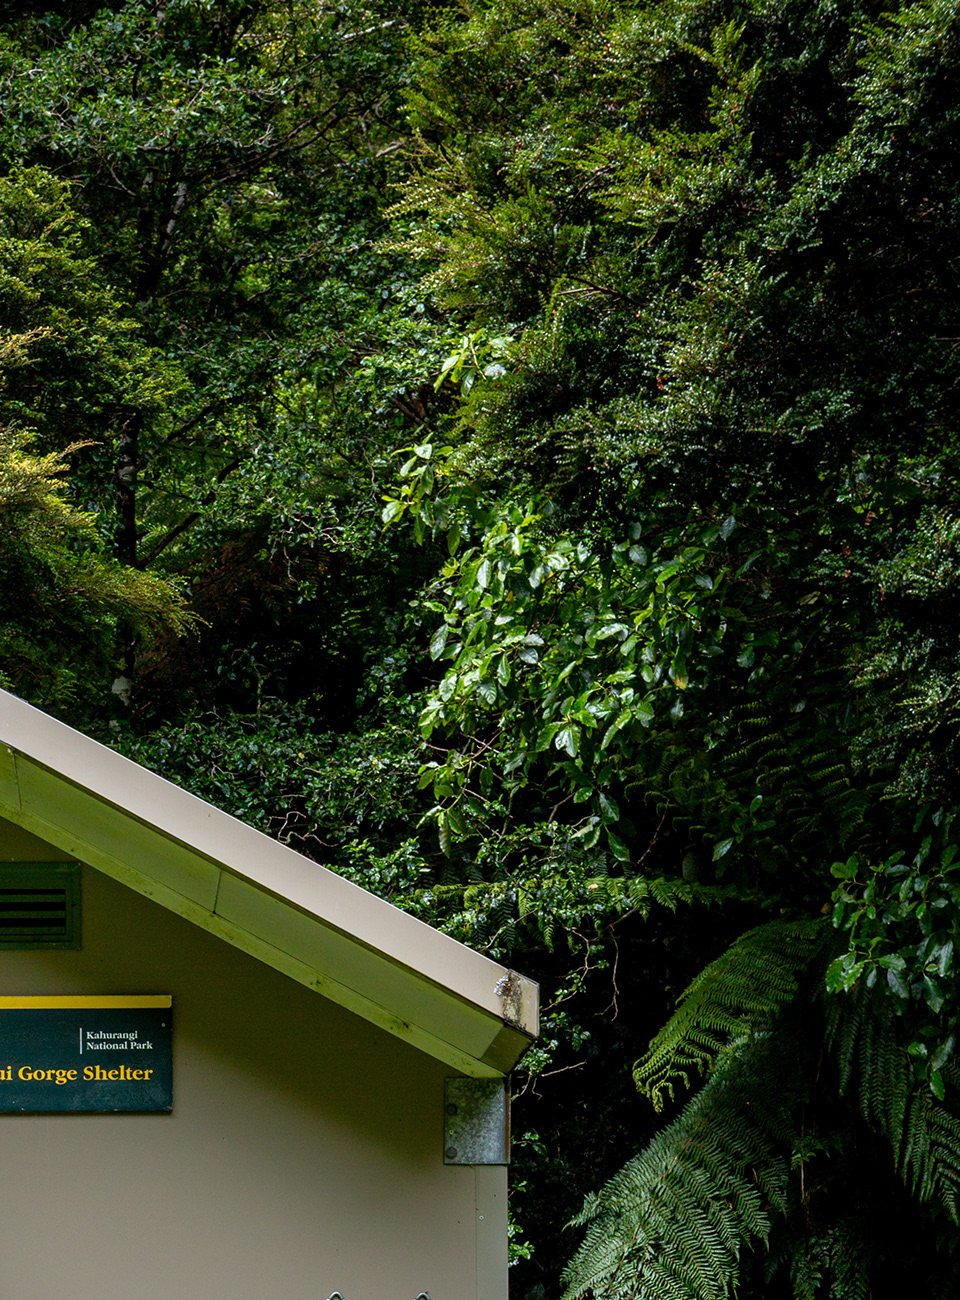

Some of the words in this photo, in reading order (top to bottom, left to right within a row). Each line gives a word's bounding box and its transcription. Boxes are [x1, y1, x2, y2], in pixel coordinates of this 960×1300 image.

[86, 1031, 138, 1041] Kahurangi
[86, 1041, 128, 1050] National
[130, 1041, 153, 1050] Park
[18, 1066, 77, 1085] Gorge
[83, 1065, 153, 1081] Shelter
